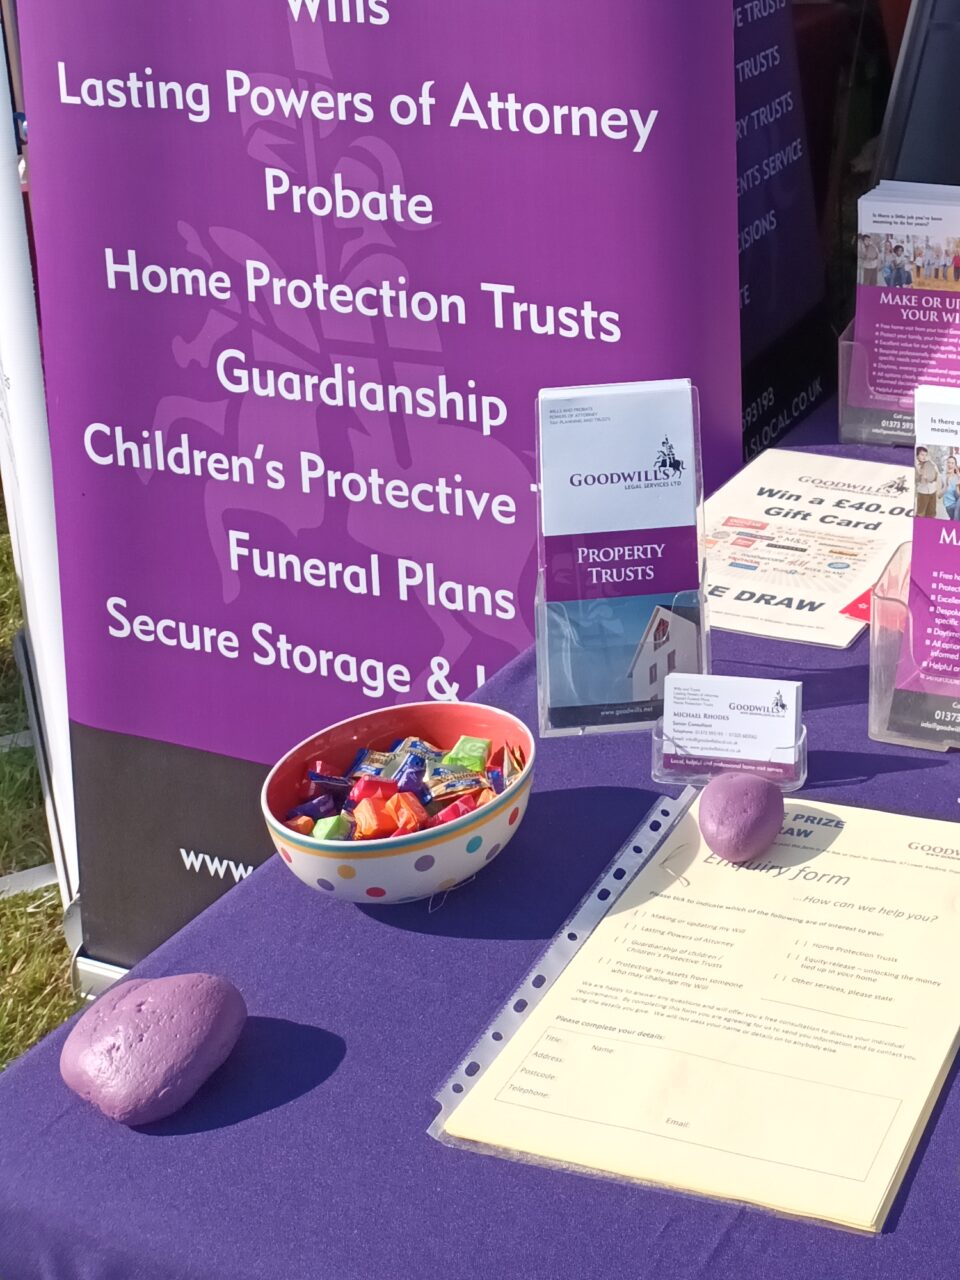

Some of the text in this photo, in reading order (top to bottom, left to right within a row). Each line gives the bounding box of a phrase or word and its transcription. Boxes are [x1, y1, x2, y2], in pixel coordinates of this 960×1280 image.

[736, 45, 780, 83] TRUSTS
[56, 61, 658, 153] Lasting Powers of Attorney
[751, 91, 794, 130] TRUSTS
[264, 168, 433, 225] Probate
[104, 248, 622, 343] Home Protection Trusts
[922, 296, 942, 309] OR
[900, 308, 940, 323] YOUR
[215, 348, 508, 435] Guardianship
[83, 423, 517, 525] Children's Protective
[570, 470, 670, 487] GOODWILLS
[798, 475, 892, 495] GOODWILLS
[756, 487, 800, 502] Win
[808, 496, 824, 506] a
[764, 506, 882, 531] Gift Card
[228, 531, 516, 620] Funeral Plans
[734, 590, 826, 612] DRAW
[106, 599, 460, 702] Secure Storage &
[729, 702, 780, 715] GOODWILLS
[792, 813, 847, 829] PRIZE
[789, 865, 850, 887] form
[833, 900, 939, 923] can we help you?
